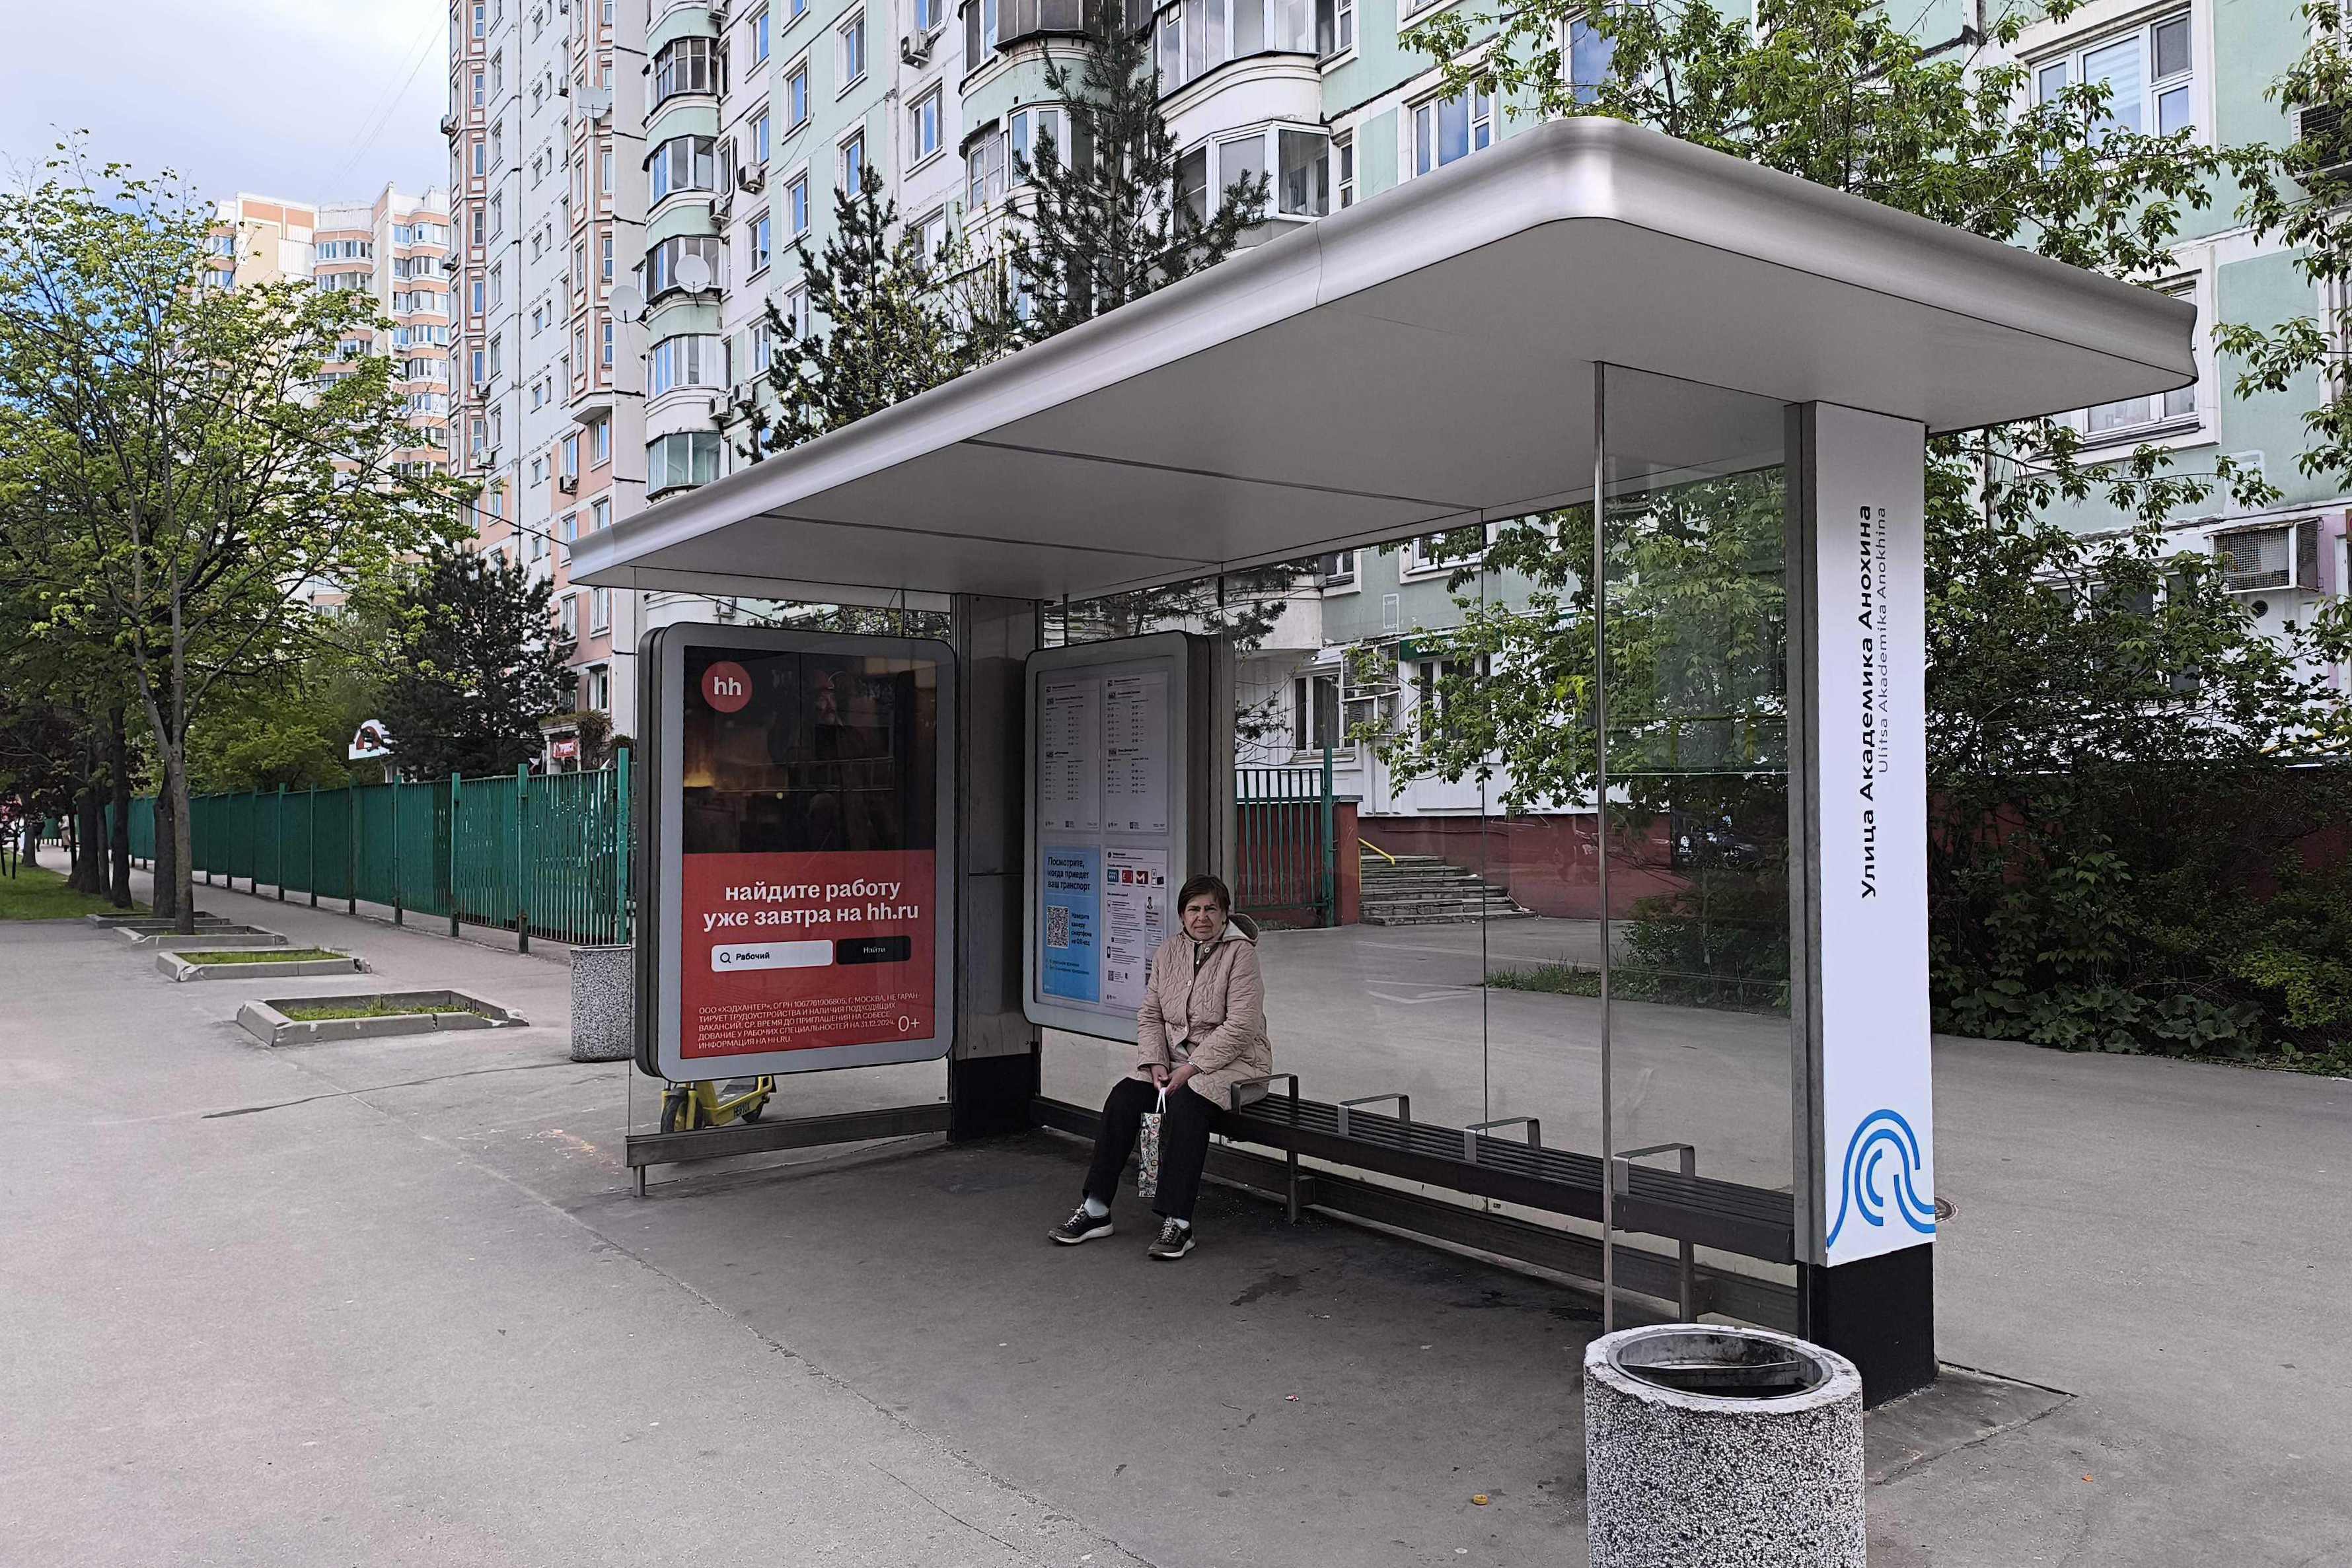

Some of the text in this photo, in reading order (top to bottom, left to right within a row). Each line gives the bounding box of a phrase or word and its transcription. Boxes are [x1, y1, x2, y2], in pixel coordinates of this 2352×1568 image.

[1876, 507, 1888, 773] Ulitsa Akademika Anokhina
[713, 676, 743, 696] hh
[1857, 505, 1876, 899] Улица Академика Анохина
[1048, 857, 1085, 869] Посмотрите,
[1065, 871, 1089, 879] приедет
[725, 878, 901, 904] найдите работу
[1060, 882, 1091, 892] транспорт
[703, 903, 918, 932] уже завтра на hh.ru
[736, 952, 770, 962] Рабочий
[863, 946, 886, 954] Найти
[698, 1015, 728, 1023] ТИРУЕТ
[729, 1009, 800, 1021] ТРУДОУСТРОЙСТВА
[809, 1005, 844, 1015] НАЛИЧИЯ
[846, 1002, 896, 1013] ПОДХОДЯЩИХ
[699, 1006, 717, 1015] ООО
[773, 1001, 793, 1009] ОГРН
[855, 995, 886, 1003] МОСКВА,
[698, 1022, 743, 1032] ВАКАНСИЙ.
[757, 1018, 783, 1028] ВРЕМЯ
[796, 1013, 851, 1024] ПРИГЛАШЕНИЯ
[698, 1030, 738, 1042] ДОВАНИЕ
[743, 1028, 778, 1037] РАБОЧИХ
[780, 1022, 848, 1034] СПЕЦИАЛЬНОСТЕЙ
[898, 1015, 920, 1032] 0+
[698, 1039, 754, 1050] ИНФОРМАЦИЯ
